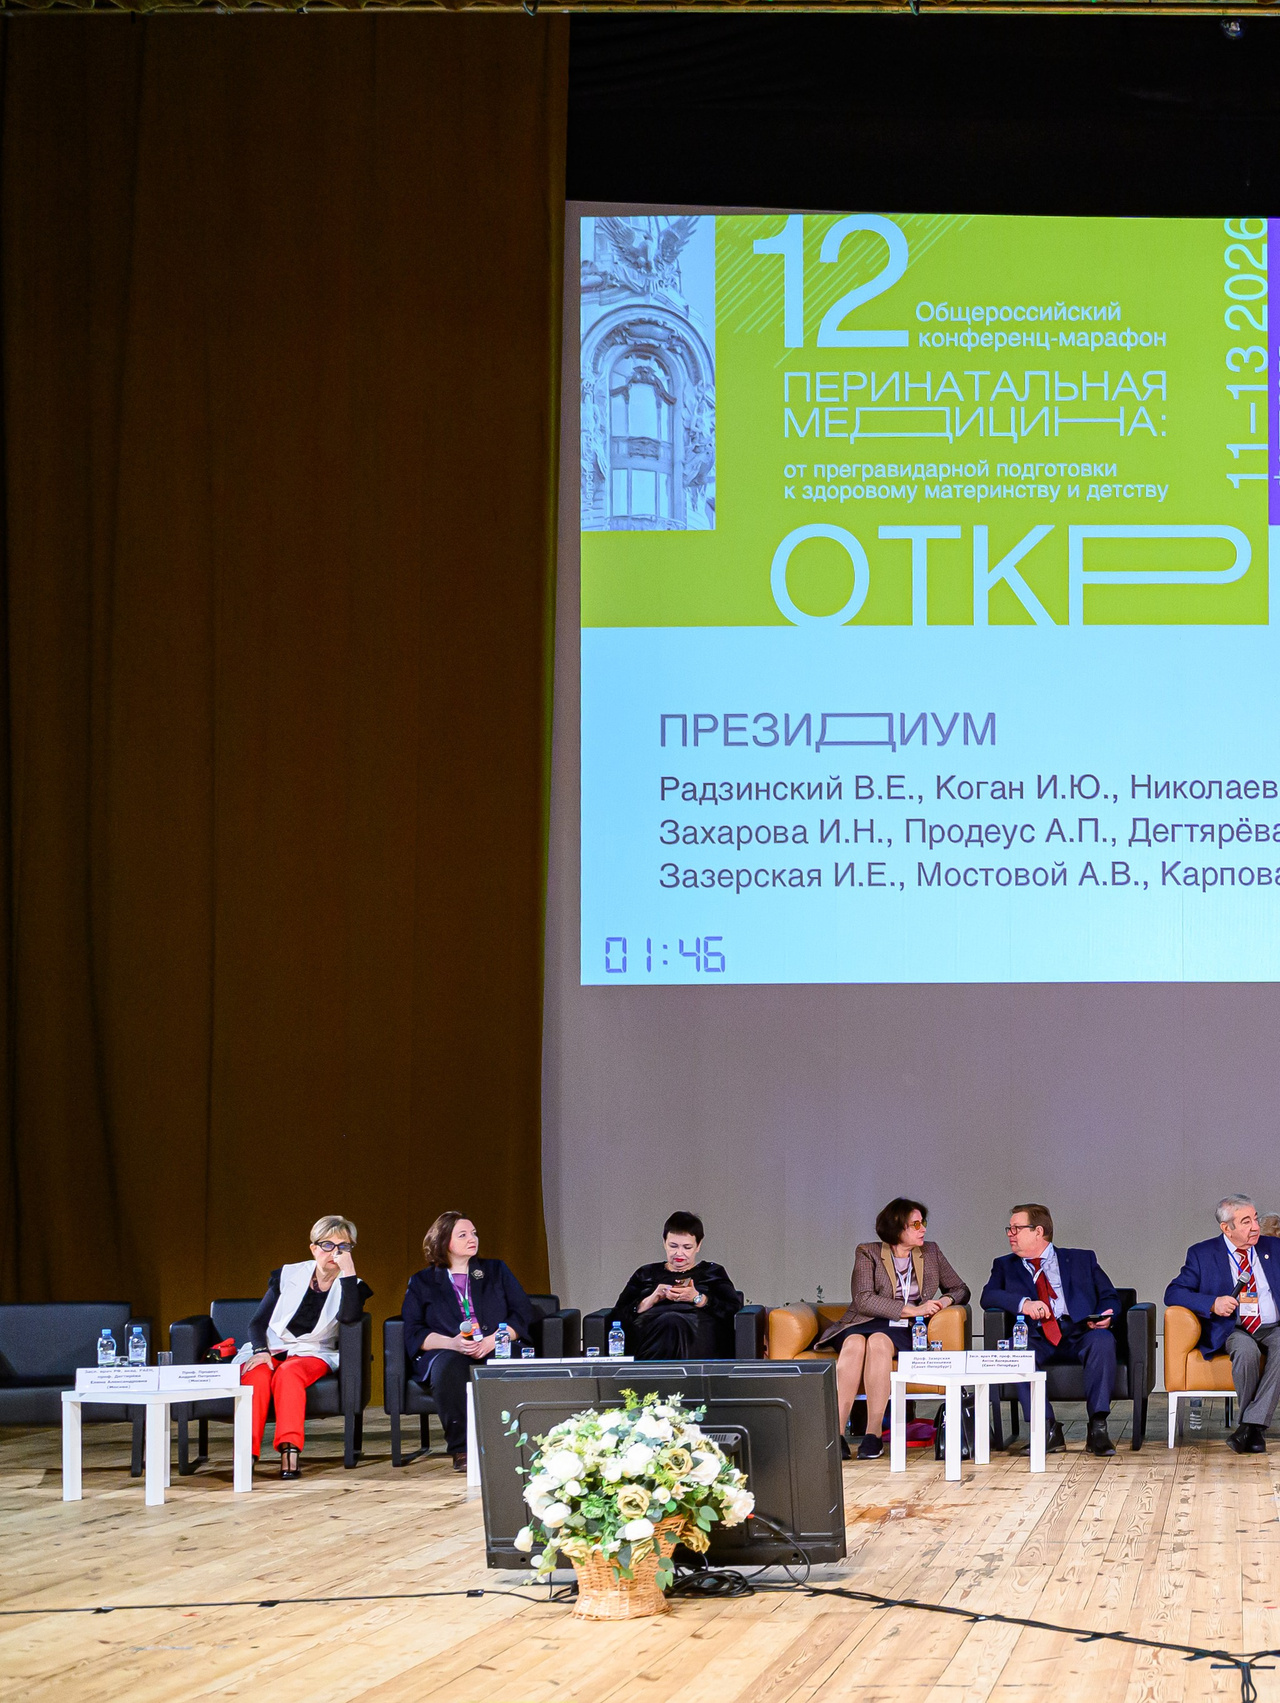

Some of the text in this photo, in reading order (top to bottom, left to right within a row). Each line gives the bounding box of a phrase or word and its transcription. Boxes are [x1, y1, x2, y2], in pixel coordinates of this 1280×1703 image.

[754, 215, 909, 348] 12
[1225, 217, 1268, 331] 2026
[916, 301, 1121, 326] Общероссийский
[919, 327, 1166, 352] конференц-марафон
[784, 371, 1166, 402] ПЕРИНАТАЛЬНАЯ
[784, 406, 1166, 444] МЕДИЦИНА:
[784, 460, 1117, 482] от прегравидарной подготовки
[785, 484, 1168, 503] к здоровому материнству и детству
[660, 712, 995, 753] ПРЕЗИДИУМ
[661, 775, 842, 805] Радзинский
[855, 775, 923, 804] В.Е.,
[937, 775, 1023, 800] Коган
[1037, 774, 1117, 803] И.Ю.,
[660, 819, 808, 850] Захарова
[820, 819, 892, 848] И.Н.,
[906, 819, 1035, 850] Продеус
[1045, 818, 1116, 847] А.П.,
[660, 863, 821, 894] Зазерская
[835, 862, 904, 891] И.Е.,
[918, 861, 1066, 886] Мостовой
[1078, 861, 1148, 890] А.В.,
[605, 936, 725, 973] 01:46
